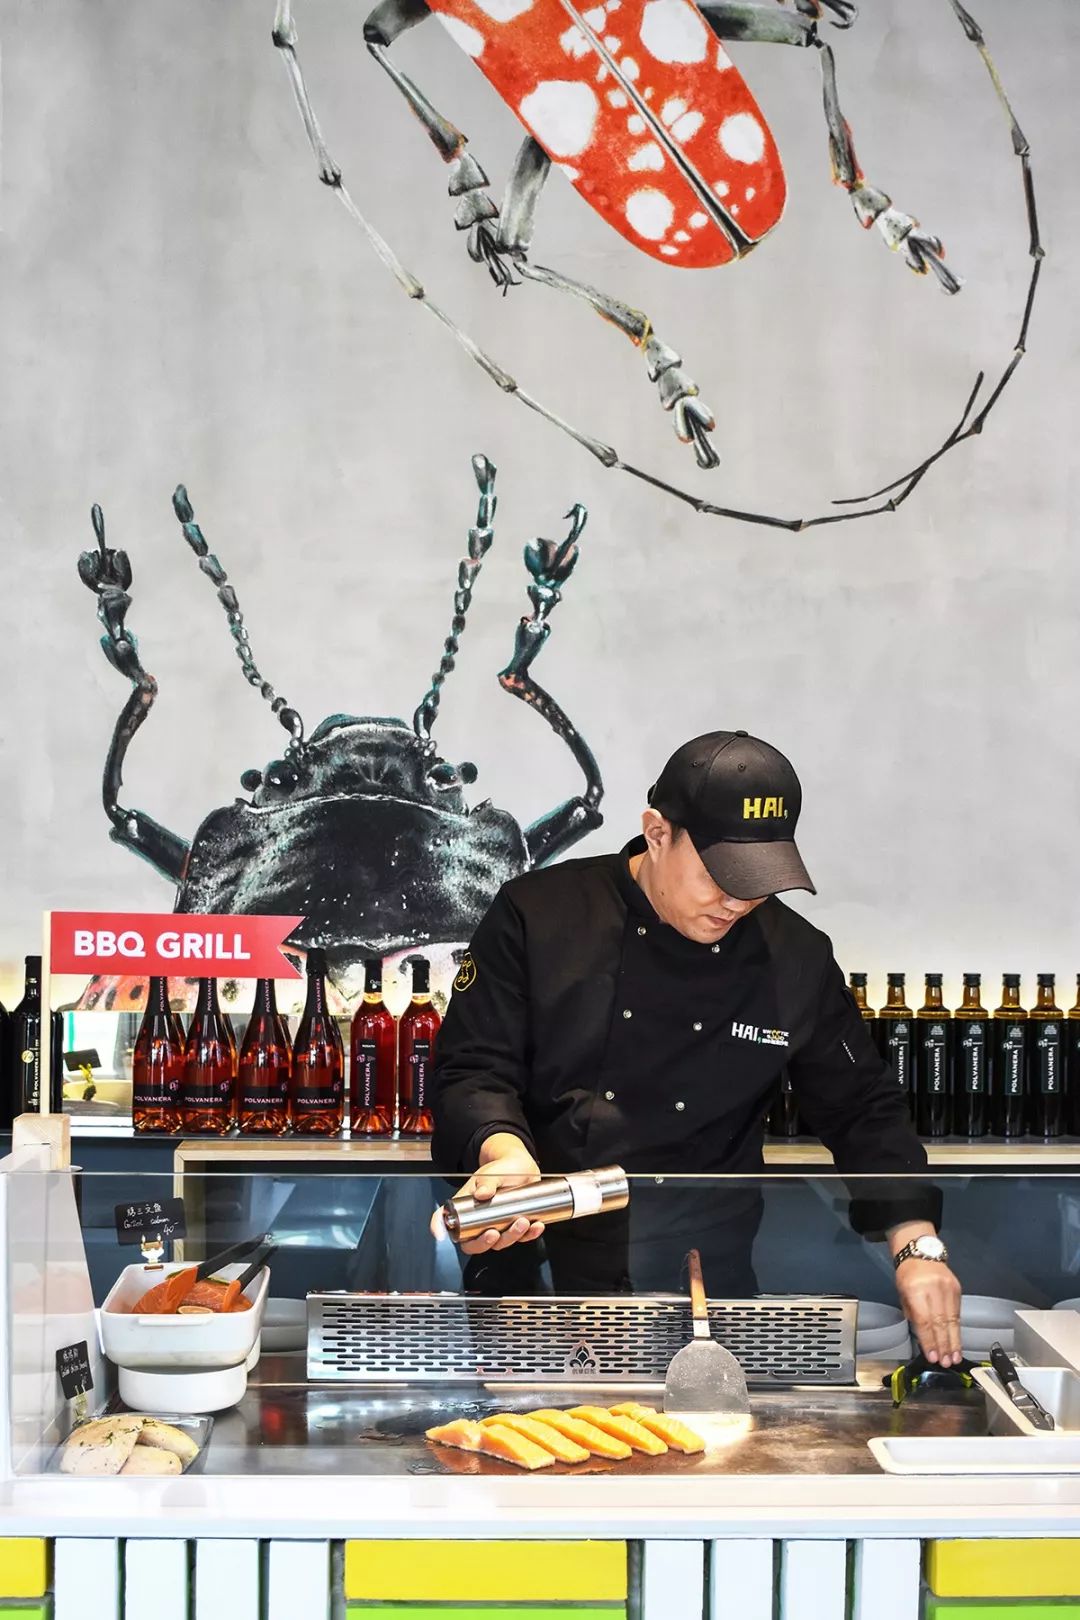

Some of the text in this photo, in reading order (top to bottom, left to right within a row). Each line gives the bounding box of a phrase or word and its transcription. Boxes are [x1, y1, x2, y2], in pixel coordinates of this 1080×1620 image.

[743, 797, 788, 819] HAI,
[74, 930, 251, 960] BBQ GRILL
[731, 1021, 762, 1045] HAI,
